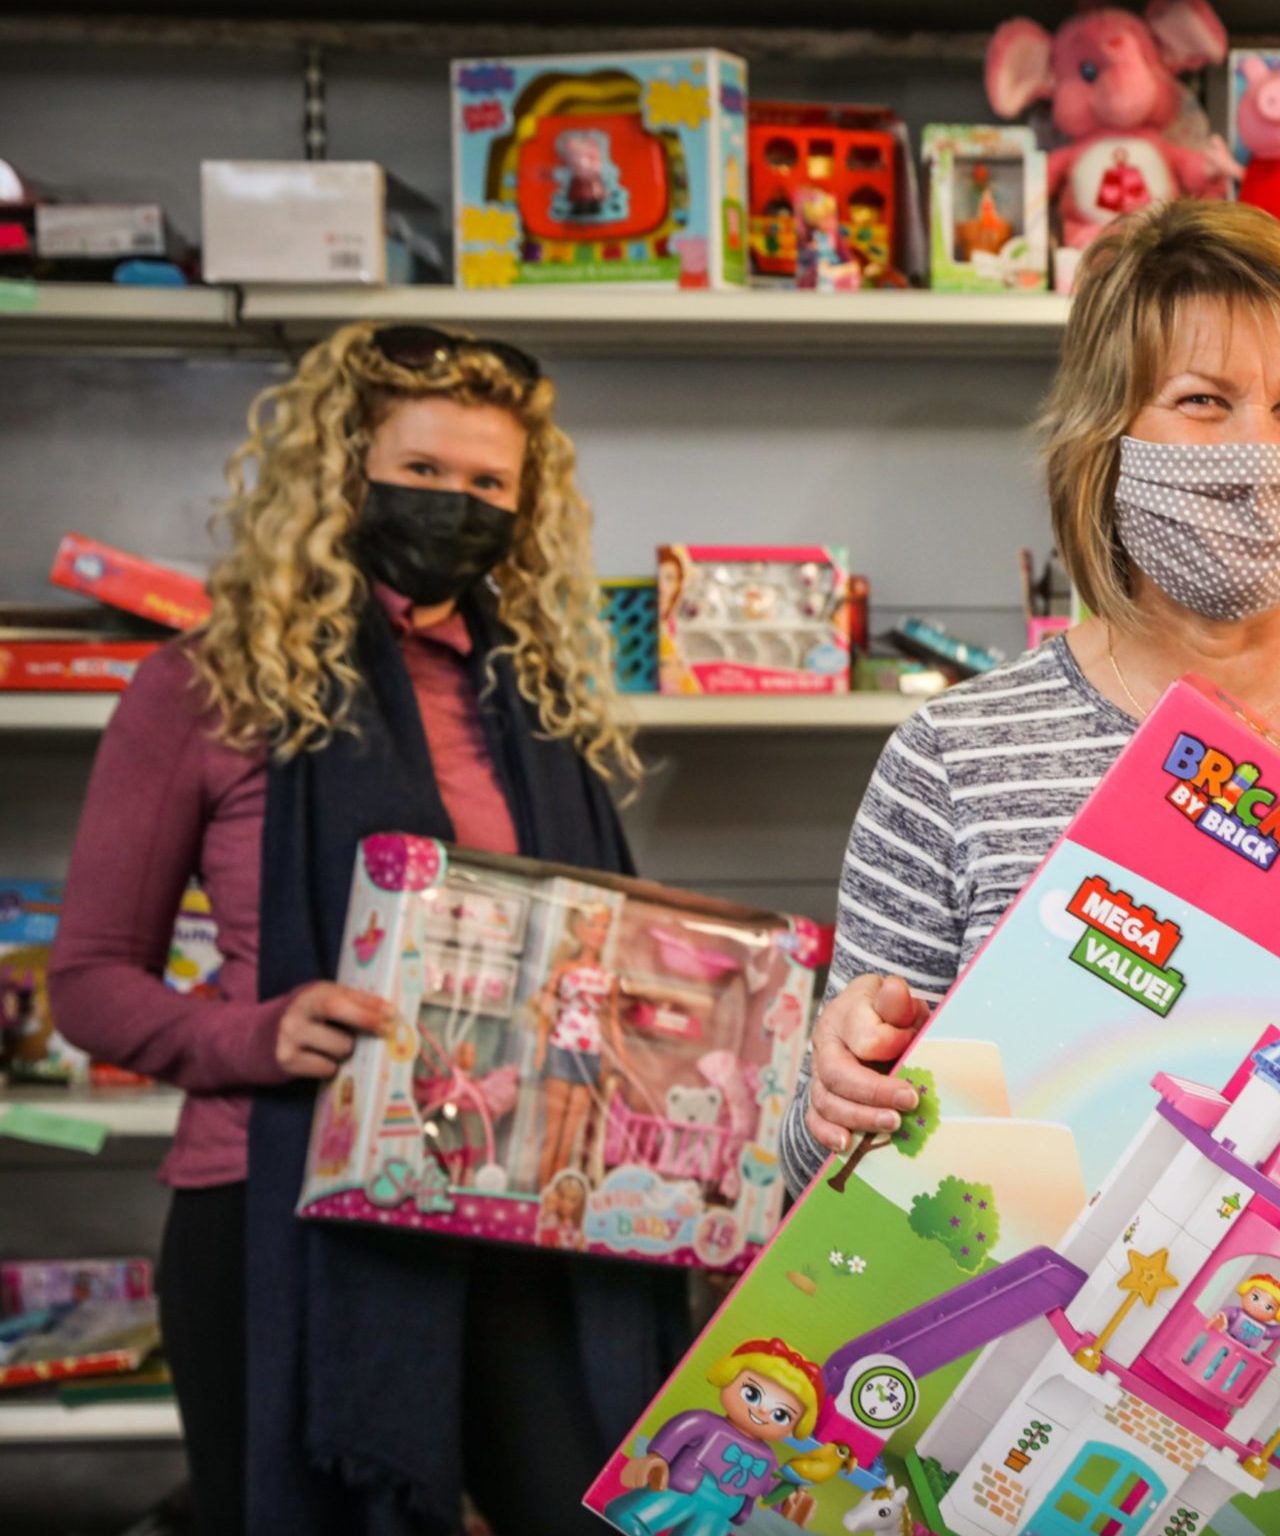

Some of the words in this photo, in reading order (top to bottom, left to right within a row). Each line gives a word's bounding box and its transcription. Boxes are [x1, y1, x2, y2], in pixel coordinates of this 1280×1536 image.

[1170, 784, 1206, 815] BY
[1201, 808, 1274, 865] BRICK
[1081, 891, 1161, 955] MEGA
[1085, 937, 1175, 1007] VALUE!
[617, 1211, 682, 1241] baby
